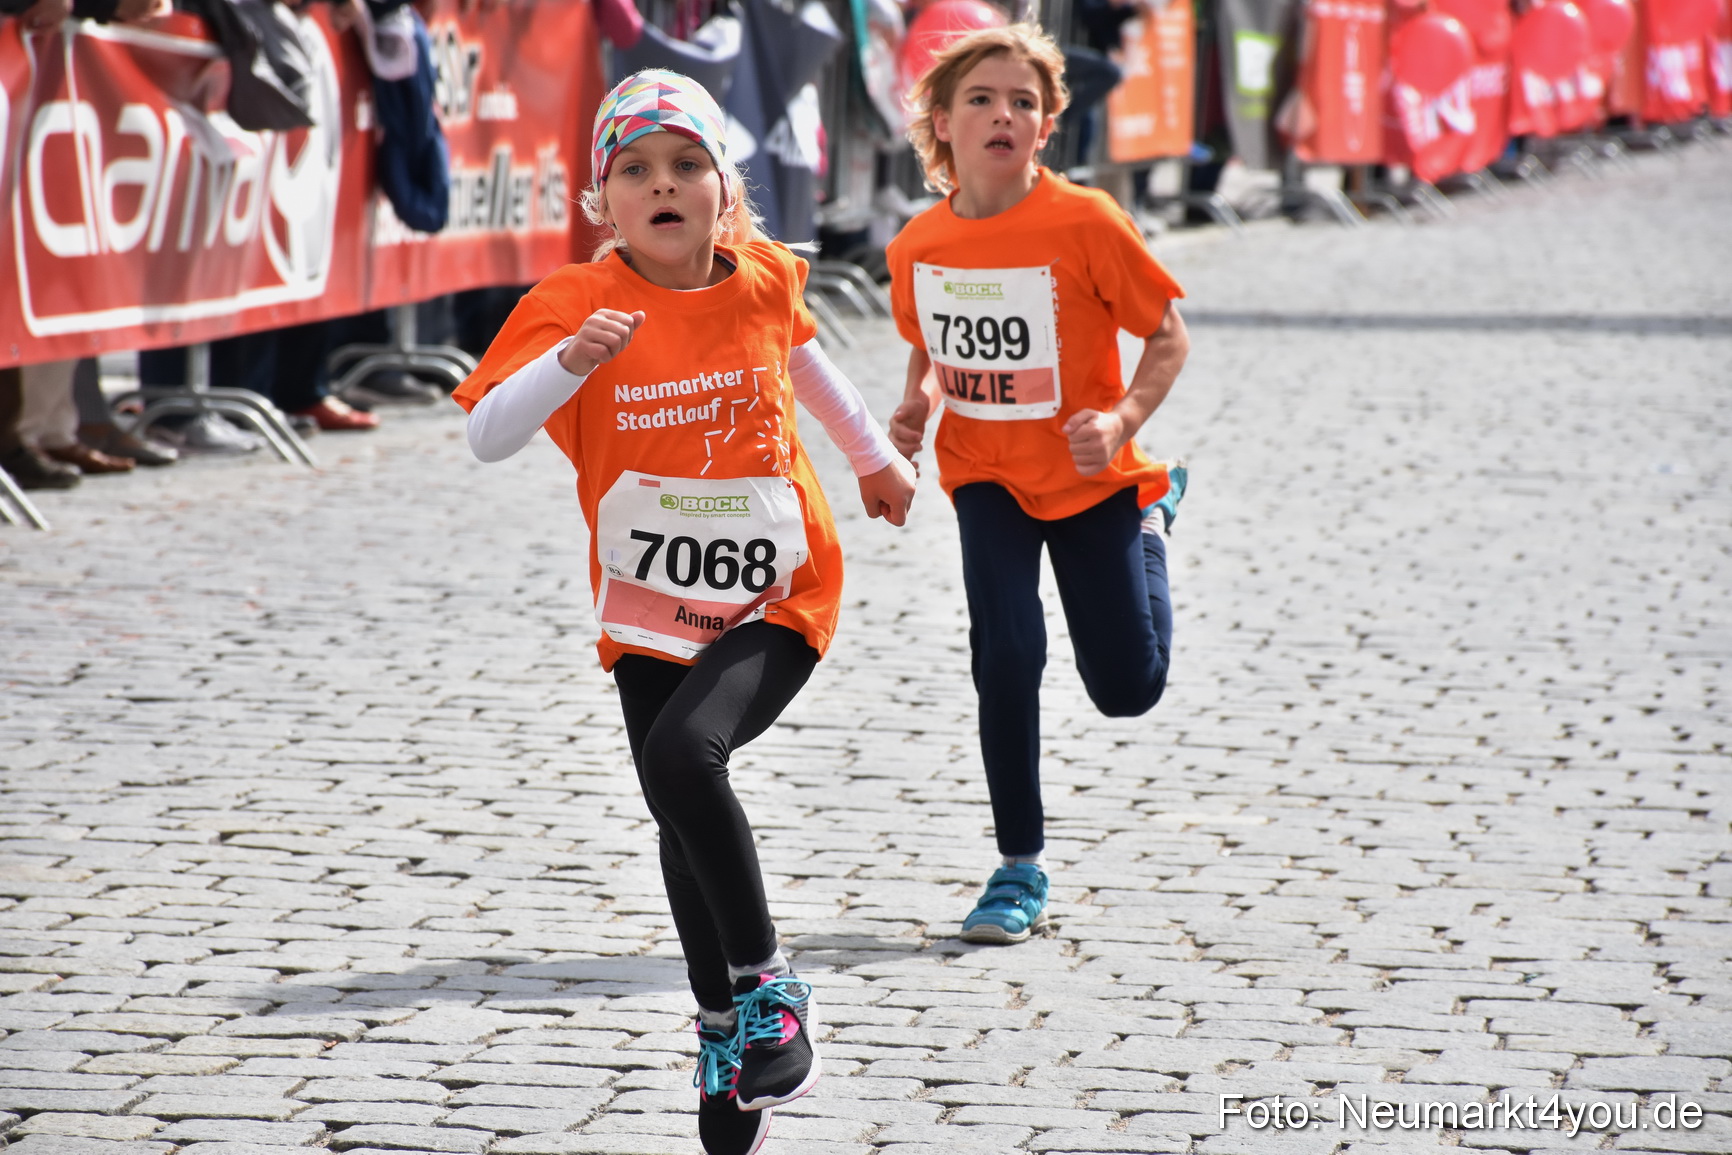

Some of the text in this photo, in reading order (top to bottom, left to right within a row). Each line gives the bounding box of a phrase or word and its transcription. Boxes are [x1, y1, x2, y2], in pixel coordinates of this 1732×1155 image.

[954, 282, 1004, 297] BOCK
[932, 313, 1030, 361] 7399
[614, 368, 745, 403] Neumarkter
[941, 366, 1017, 405] LUZIE
[616, 397, 723, 432] Stadtlauf
[680, 496, 750, 512] BOCK
[630, 529, 777, 593] 7068
[674, 604, 725, 632] Anna
